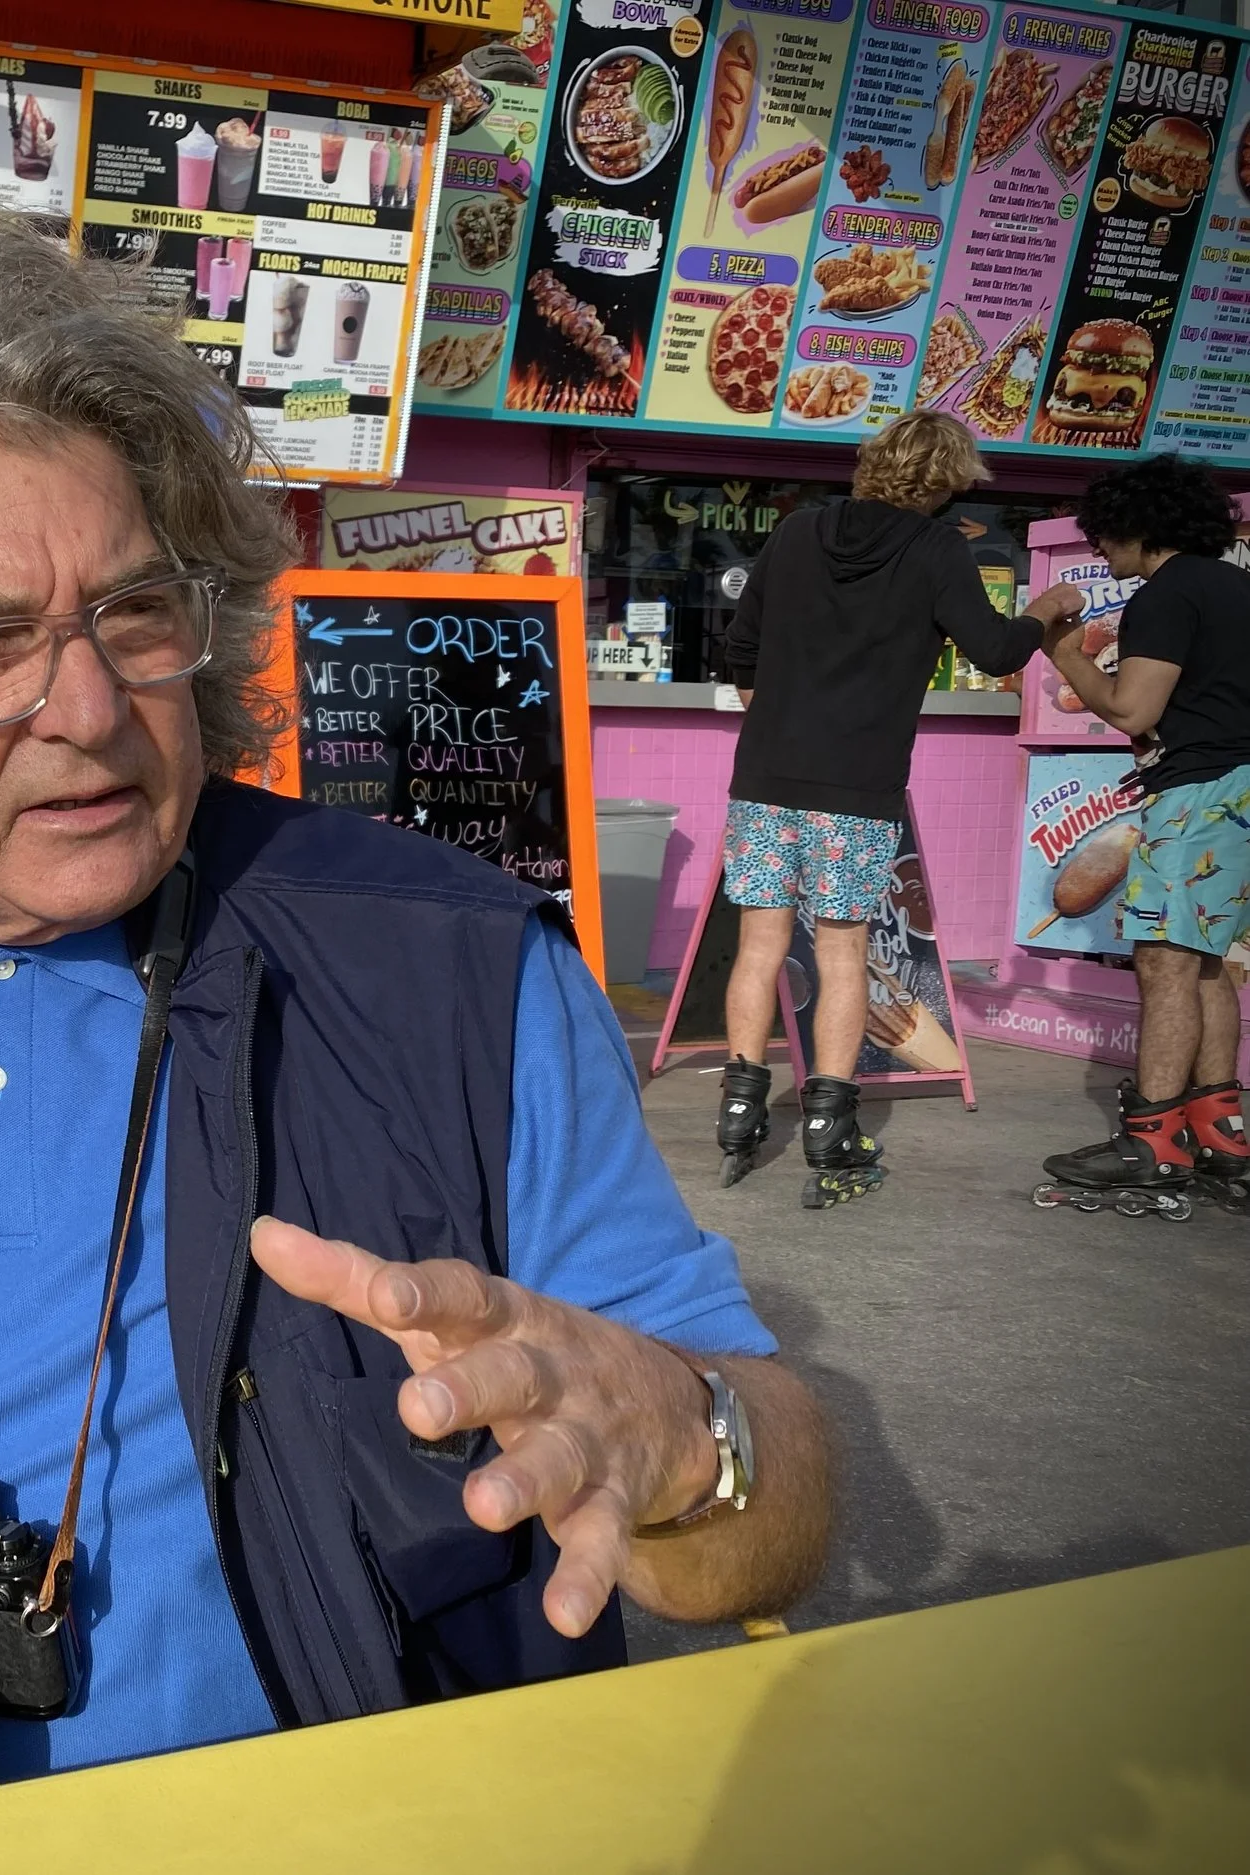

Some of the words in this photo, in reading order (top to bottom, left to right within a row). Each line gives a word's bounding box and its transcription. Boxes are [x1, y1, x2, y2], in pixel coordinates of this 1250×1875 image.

[613, 1, 668, 26] BOWL
[892, 0, 941, 24] FINGER
[945, 6, 982, 28] FOOD
[782, 33, 803, 45] Classic
[804, 36, 818, 47] Dog
[1010, 16, 1019, 38] 9.
[1023, 19, 1075, 44] FRENCH
[1077, 27, 1111, 49] FRIES
[1137, 29, 1197, 49] Charbroiled
[867, 38, 889, 49] Cheese
[795, 49, 818, 61] Cheese
[819, 52, 832, 64] Dog
[865, 52, 889, 64] Chicken
[891, 55, 915, 68] Nuggets
[777, 61, 799, 71] Cheese
[800, 63, 814, 75] Dog
[154, 79, 202, 100] SHAKES
[1121, 60, 1229, 106] BURGER
[337, 101, 371, 120] BOBA
[147, 110, 188, 130] 7.99
[766, 113, 781, 124] Corn
[782, 115, 796, 127] Dog
[1116, 116, 1134, 131] Crispy
[1110, 124, 1132, 141] Chicken
[447, 154, 498, 180] TACOS
[551, 194, 600, 210] Teriyaki
[132, 208, 203, 230] SMOOTHIES
[306, 202, 332, 220] HOT
[332, 206, 377, 225] DRINKS
[262, 220, 287, 229] COFFEE
[562, 211, 655, 241] CHICKEN
[827, 212, 839, 230] 7.
[843, 213, 890, 235] TENDER
[893, 219, 904, 235] &
[907, 221, 940, 240] FRIES
[1127, 219, 1149, 230] Burger
[1209, 215, 1229, 231] Step
[261, 228, 274, 236] TEA
[1125, 230, 1147, 242] Burger
[115, 233, 154, 250] 7.99
[275, 237, 297, 246] COCOA
[578, 247, 628, 269] STICK
[1201, 246, 1221, 262] Step
[258, 252, 301, 272] FLOATS
[322, 258, 365, 278] MOCHA
[365, 264, 407, 282] FRAPPE
[710, 253, 722, 273] 5.
[726, 255, 766, 276] PIZZA
[1093, 276, 1105, 286] ABC
[1106, 277, 1126, 289] Burger
[1153, 296, 1169, 308] ABC
[1191, 285, 1211, 302] Step
[674, 313, 696, 324] Cheese
[1147, 307, 1174, 321] Burger
[1180, 325, 1200, 341] Step
[810, 334, 821, 350] 8.
[825, 334, 852, 353] FISH
[855, 338, 866, 353] &
[869, 340, 905, 357] CHIPS
[195, 348, 233, 365] 7.99
[1170, 364, 1189, 381] Step
[1154, 421, 1175, 438] Step
[702, 503, 748, 532] PICK
[754, 508, 780, 533] UP
[336, 502, 471, 554] FUNNEL
[474, 508, 566, 550] CAKE
[1061, 565, 1110, 581] FRIED
[406, 615, 554, 669] ORDER
[603, 648, 634, 664] HERE
[305, 661, 346, 695] WE
[351, 664, 457, 706] OFFER
[315, 706, 385, 736] BETTER
[407, 703, 518, 746] PRICE
[318, 741, 390, 768] BETTER
[407, 741, 525, 780] QUALITY
[324, 781, 389, 805] BETTER
[409, 778, 537, 812] QUANTITY
[1031, 781, 1080, 819] FRIED
[985, 1003, 1049, 1036] #Ocean
[1055, 1017, 1105, 1047] Front
